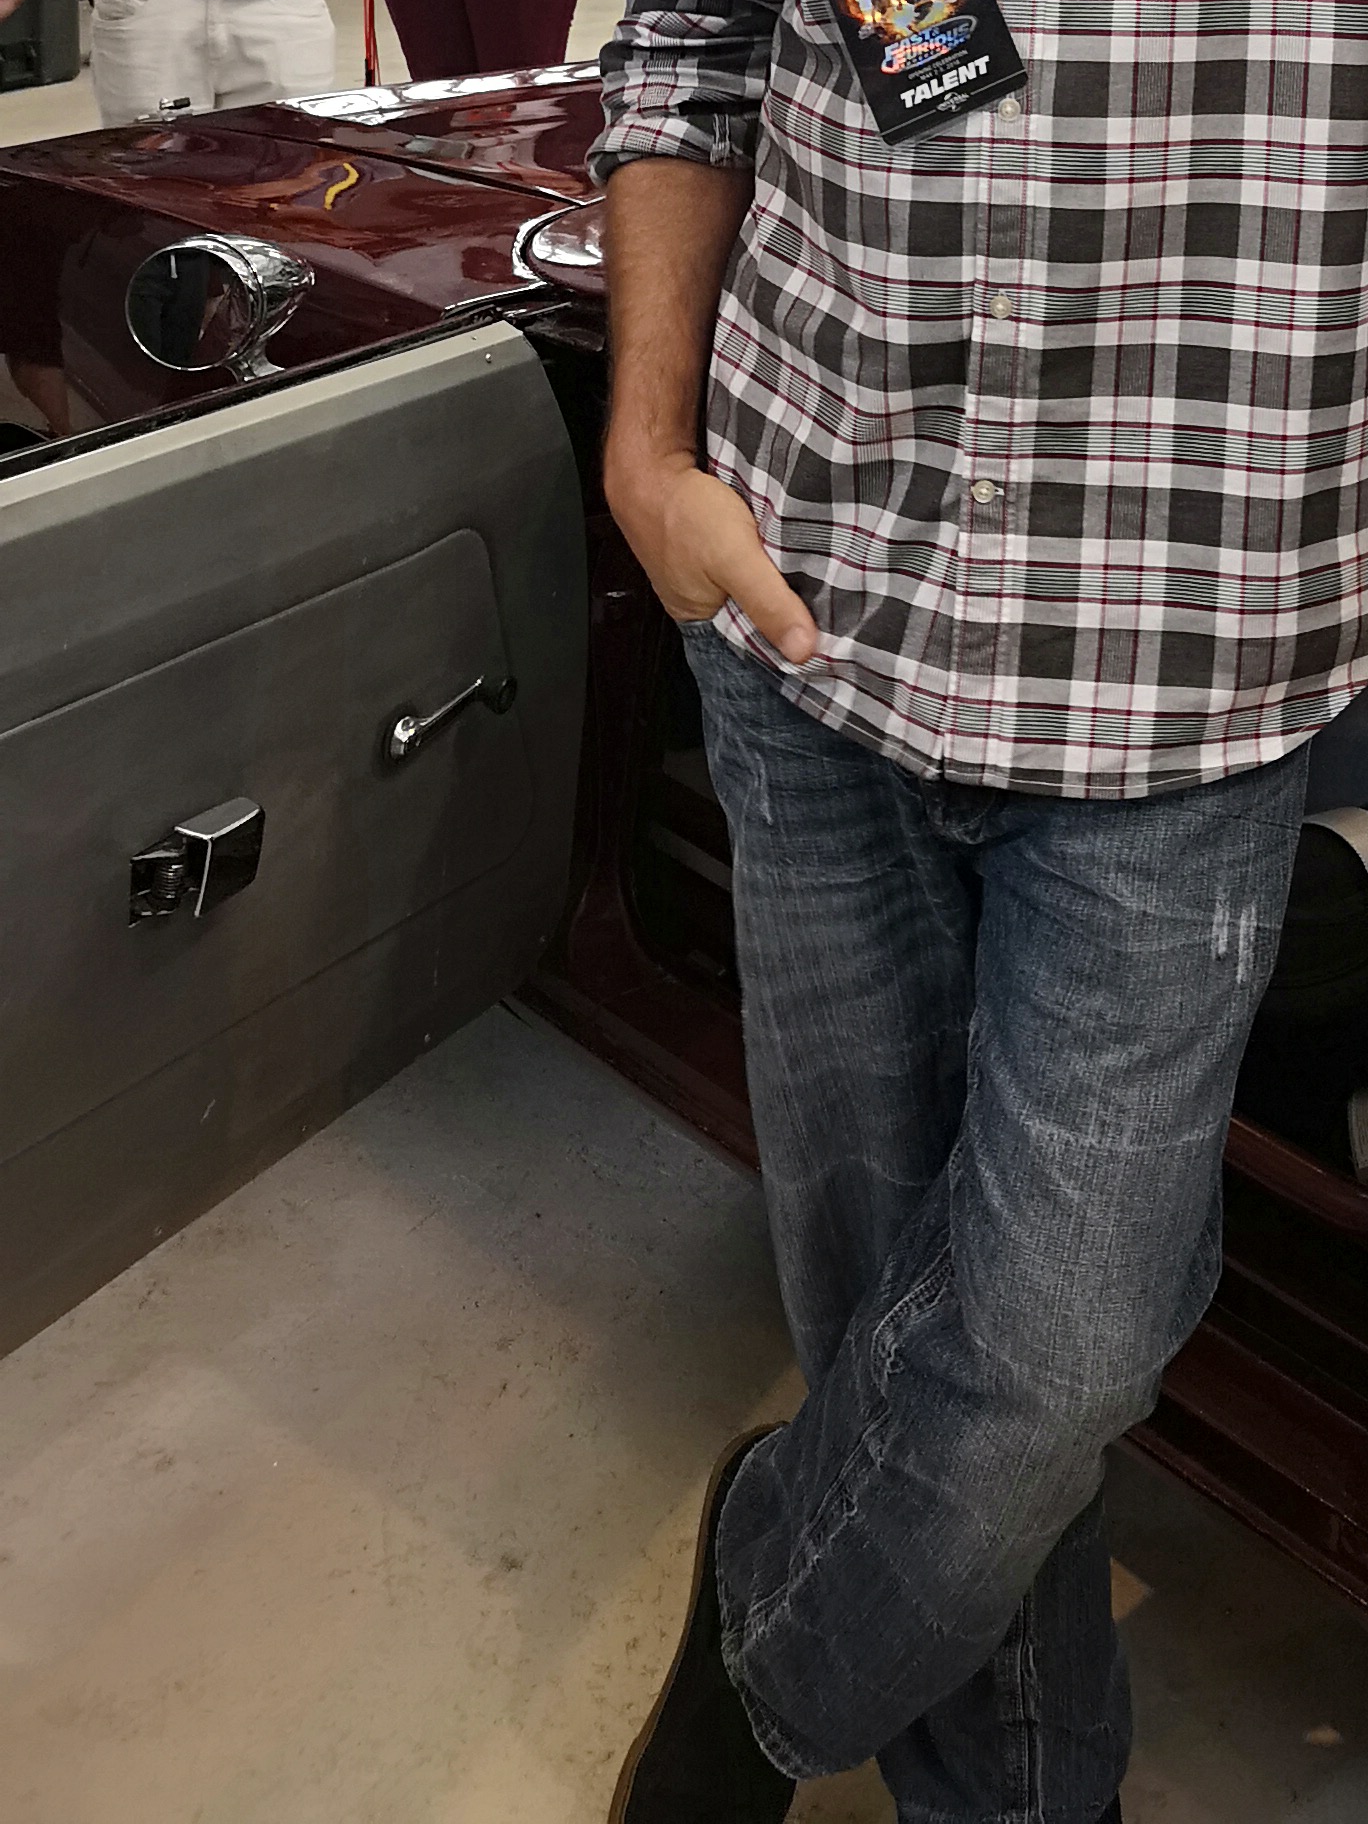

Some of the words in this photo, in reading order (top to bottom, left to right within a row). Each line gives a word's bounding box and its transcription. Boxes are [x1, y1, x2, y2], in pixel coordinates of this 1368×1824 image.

[883, 27, 933, 61] FAST
[891, 22, 971, 67] FURIOUS
[900, 55, 990, 109] TALENT
